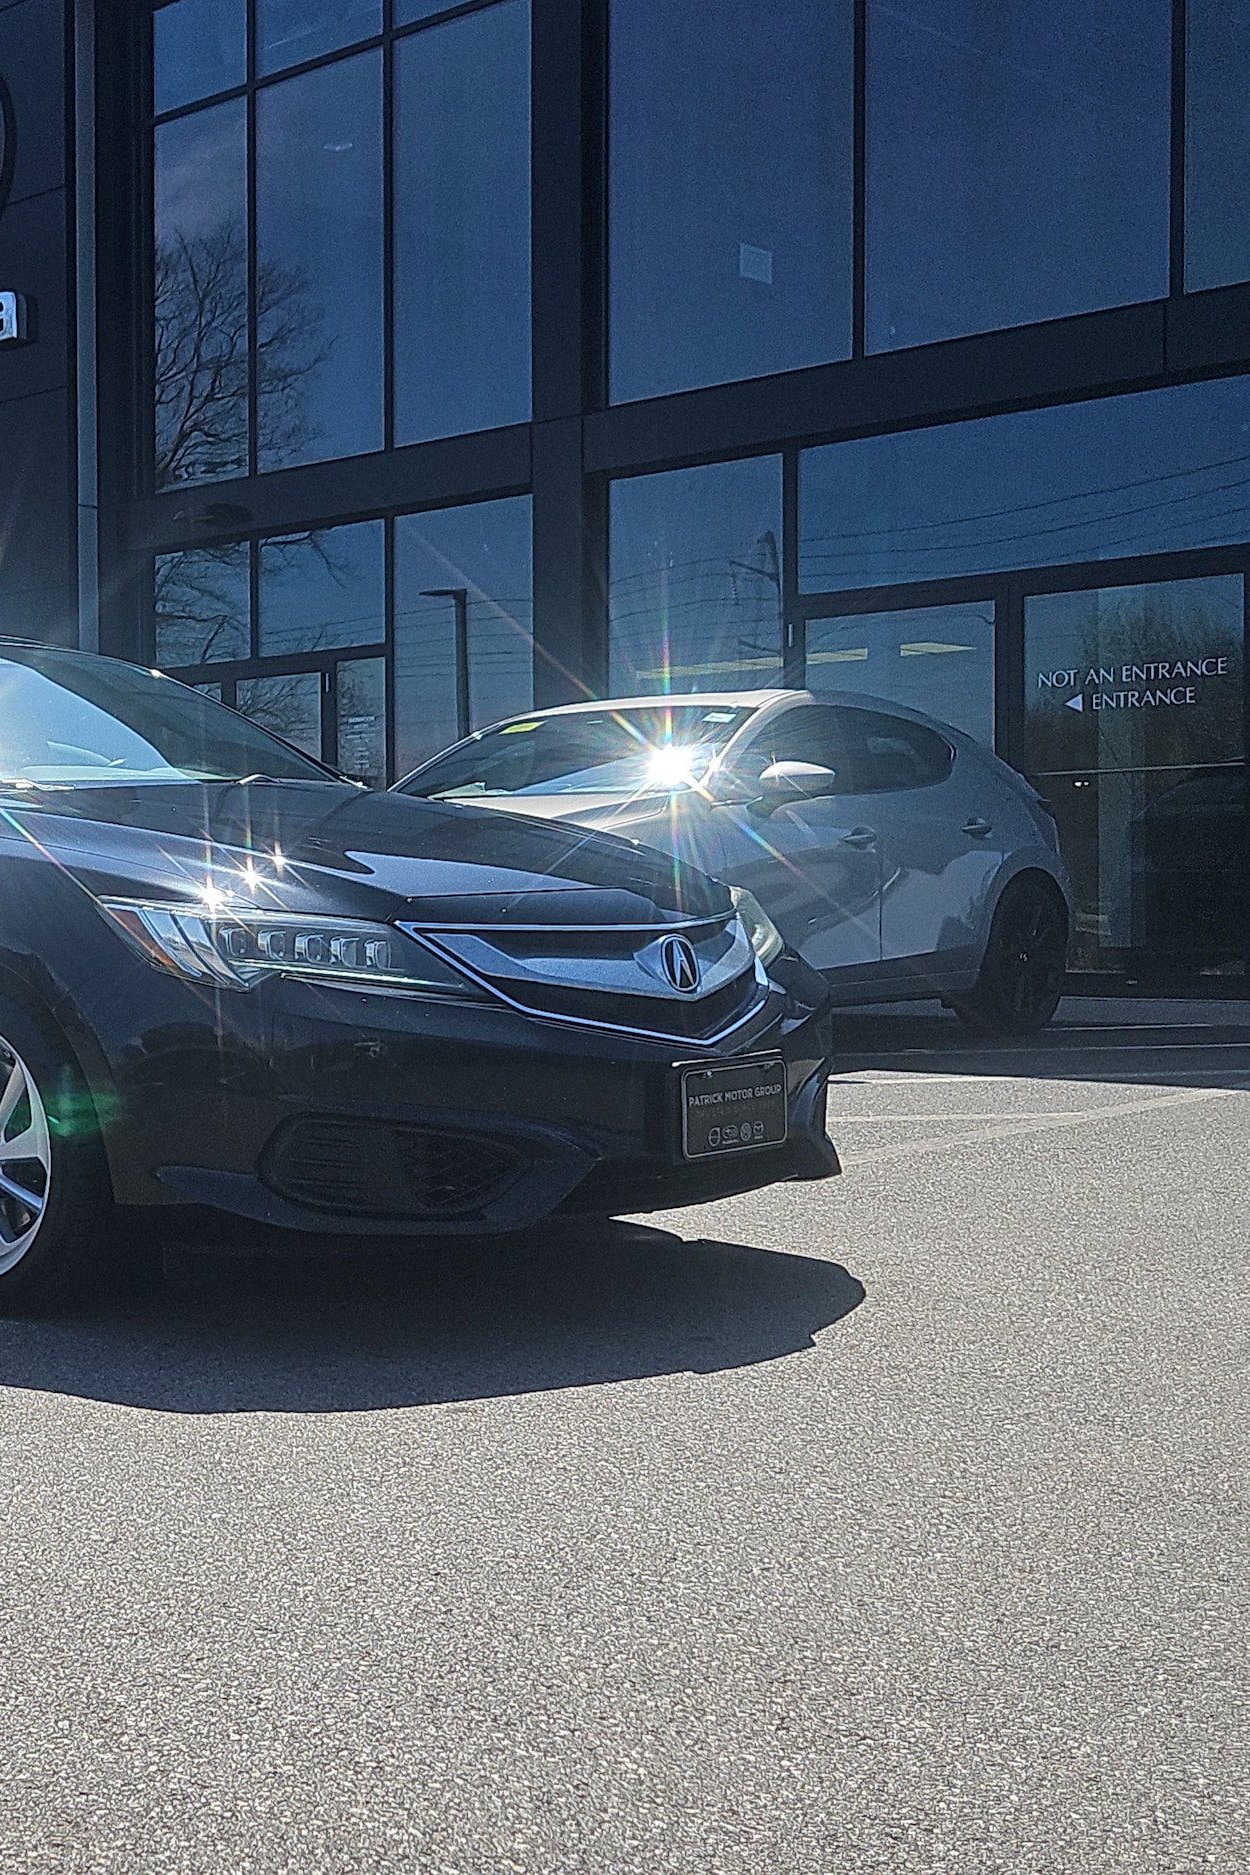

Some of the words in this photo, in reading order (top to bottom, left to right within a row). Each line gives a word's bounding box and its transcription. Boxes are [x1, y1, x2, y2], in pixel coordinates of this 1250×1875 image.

[1037, 669, 1078, 688] NOT
[1085, 667, 1114, 685] AN
[1121, 657, 1228, 682] ENTRANCE
[1092, 686, 1196, 709] ENTRANCE
[688, 1092, 723, 1107] PATRICK
[724, 1088, 753, 1102] MOTOR
[754, 1084, 782, 1097] GROUP
